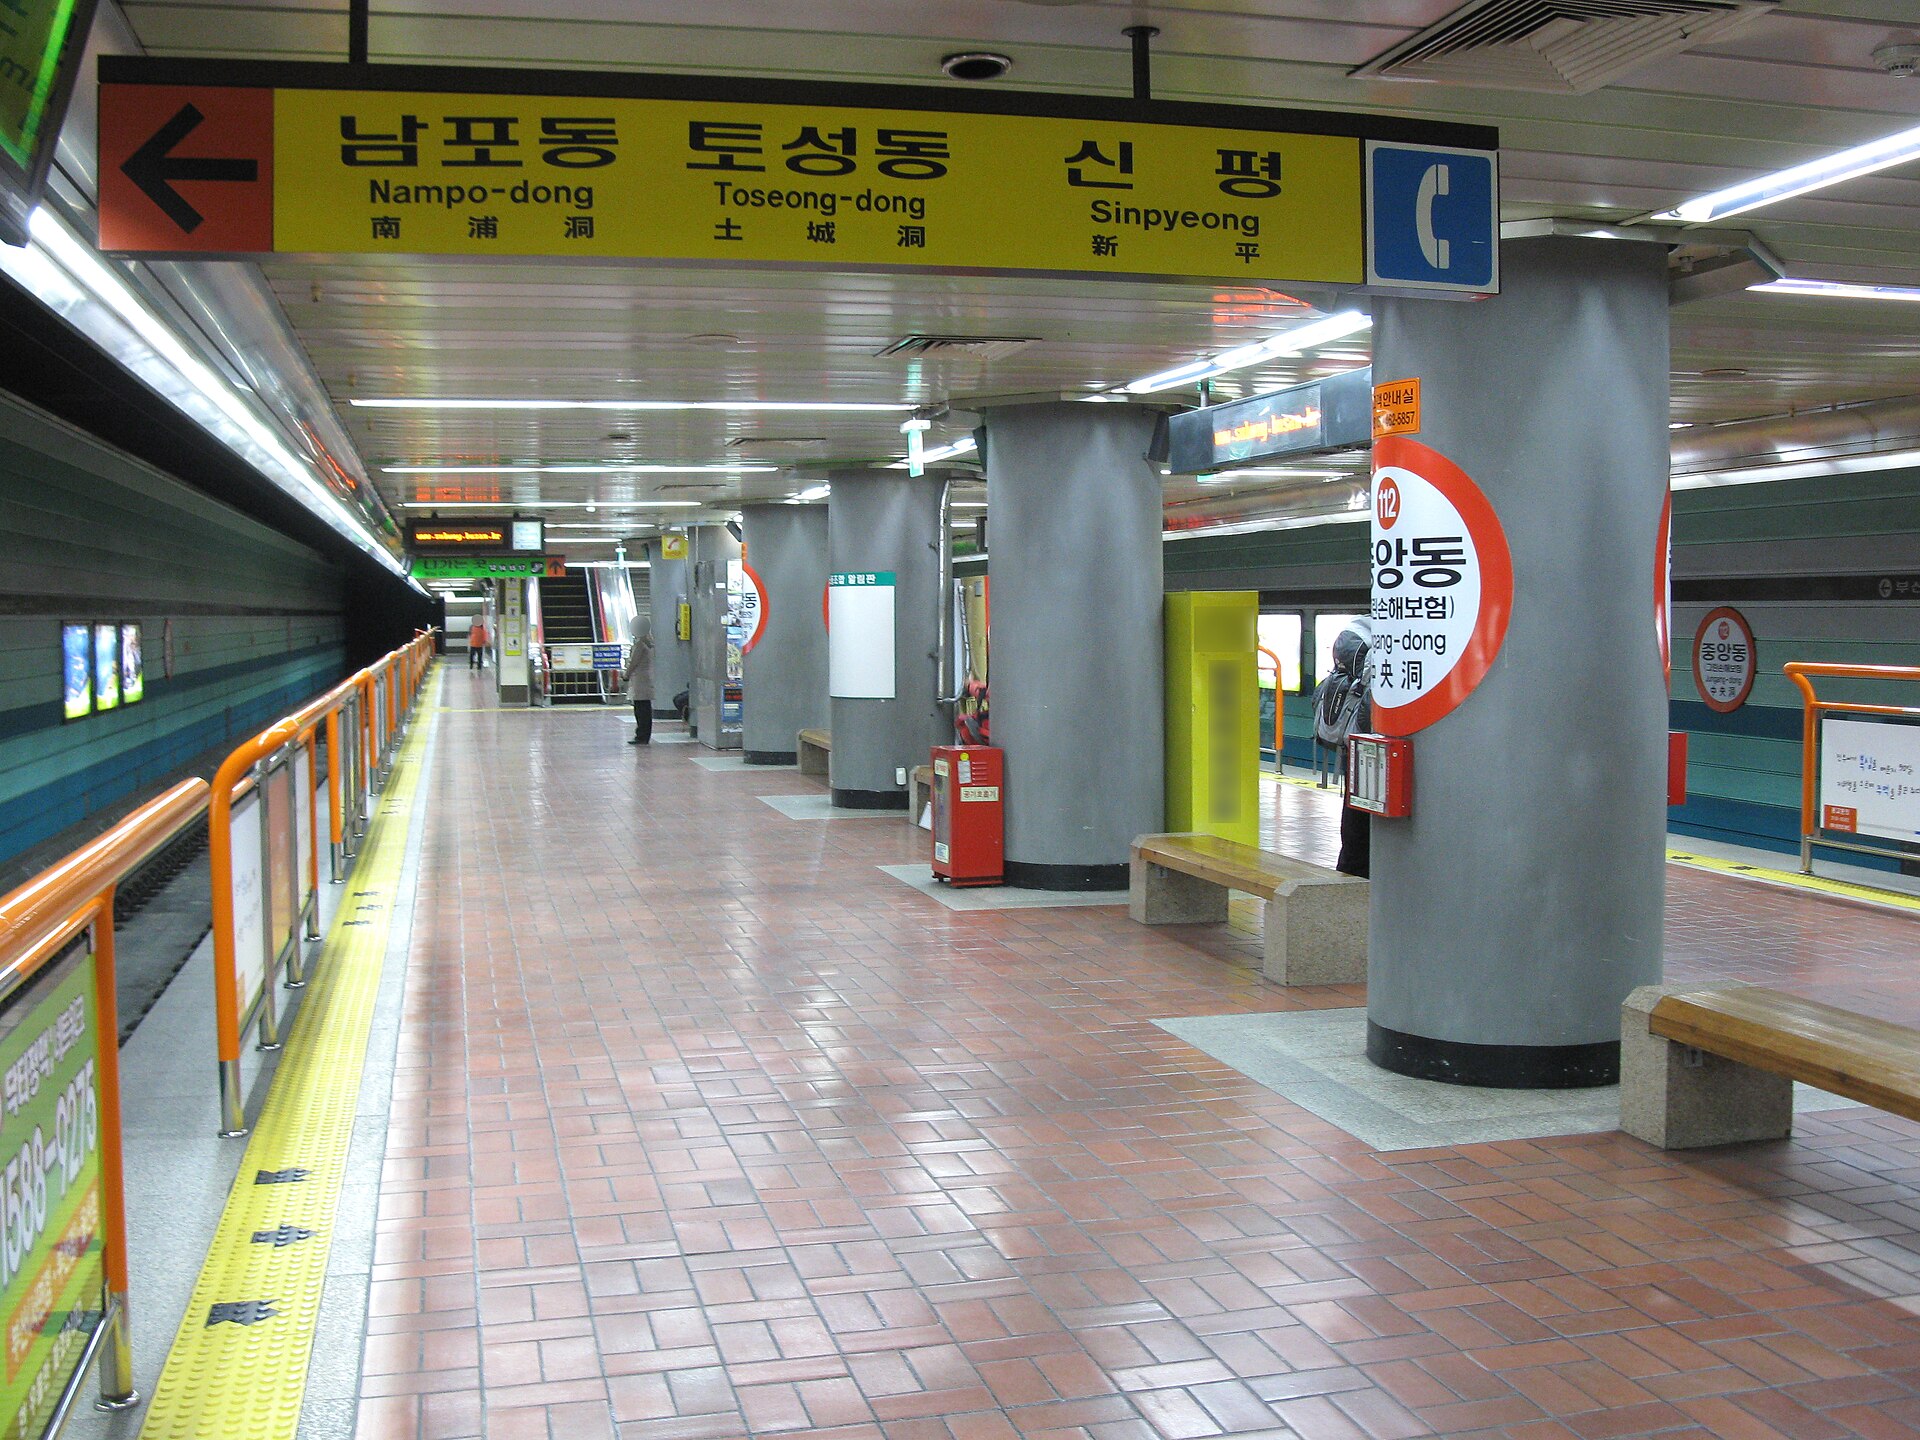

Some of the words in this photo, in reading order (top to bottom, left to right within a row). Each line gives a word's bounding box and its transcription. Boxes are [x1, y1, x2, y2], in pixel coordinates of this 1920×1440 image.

[339, 112, 619, 170] 남포동
[685, 119, 951, 182] 토성동
[369, 178, 595, 210] Nampo-dong
[712, 180, 927, 219] Toseong-dong
[1089, 198, 1262, 238] Sinpyeong
[1378, 486, 1398, 520] 112
[1701, 642, 1747, 662] 중앙동
